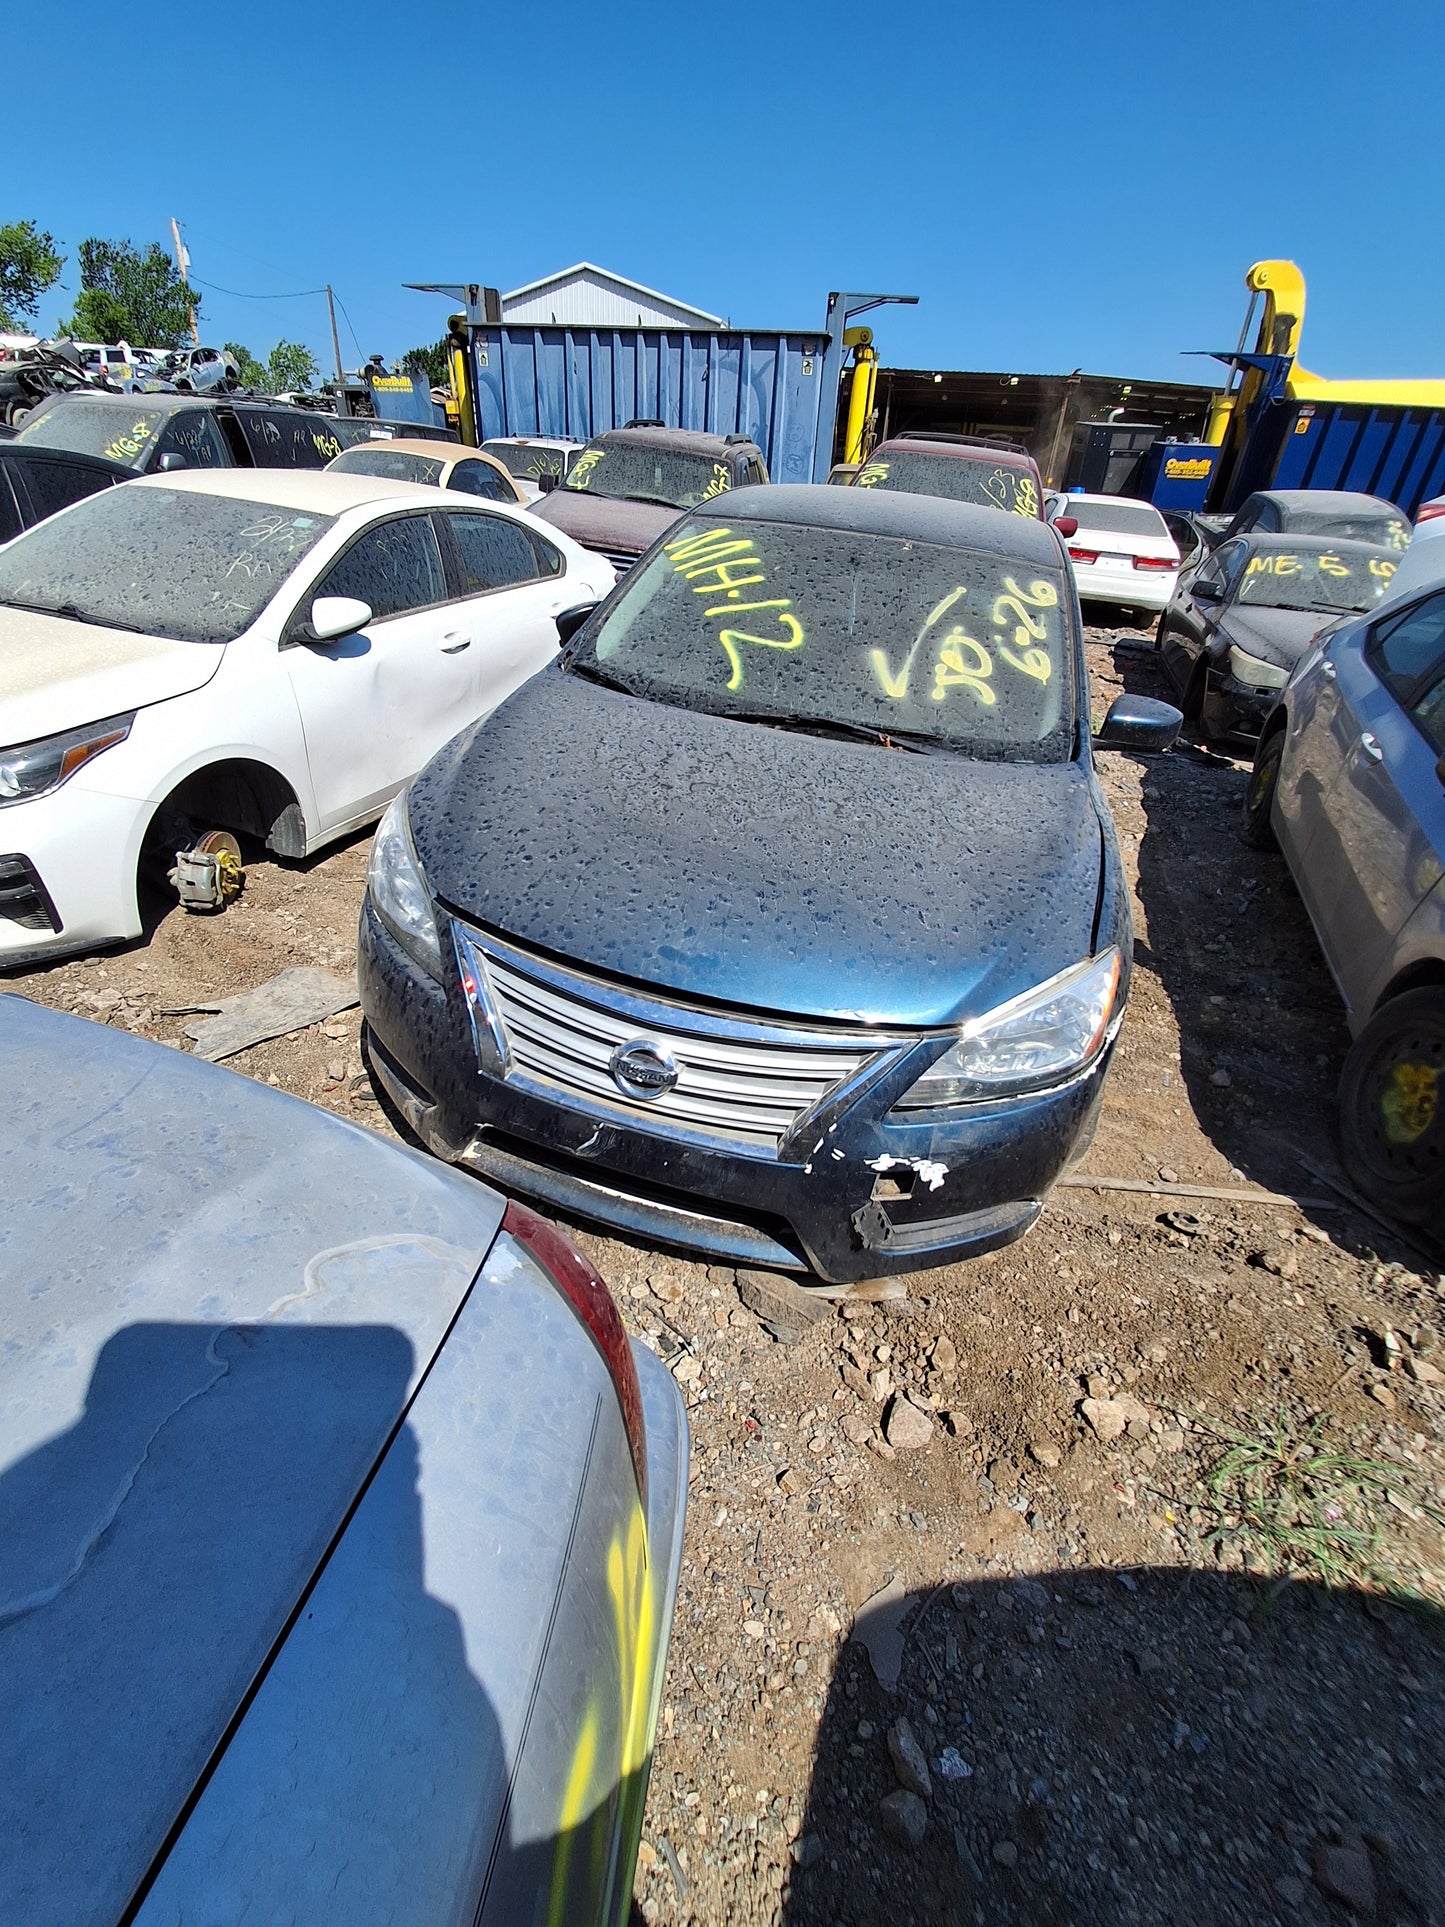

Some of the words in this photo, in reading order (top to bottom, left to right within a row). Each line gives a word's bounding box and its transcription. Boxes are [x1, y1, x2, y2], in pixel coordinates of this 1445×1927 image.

[371, 375, 413, 386] OverBuilt
[104, 422, 151, 460] MG-8
[566, 450, 605, 490] MG-7
[664, 528, 804, 690] MH-12
[993, 577, 1059, 687] 6-26
[615, 1060, 671, 1083] NISSAN
